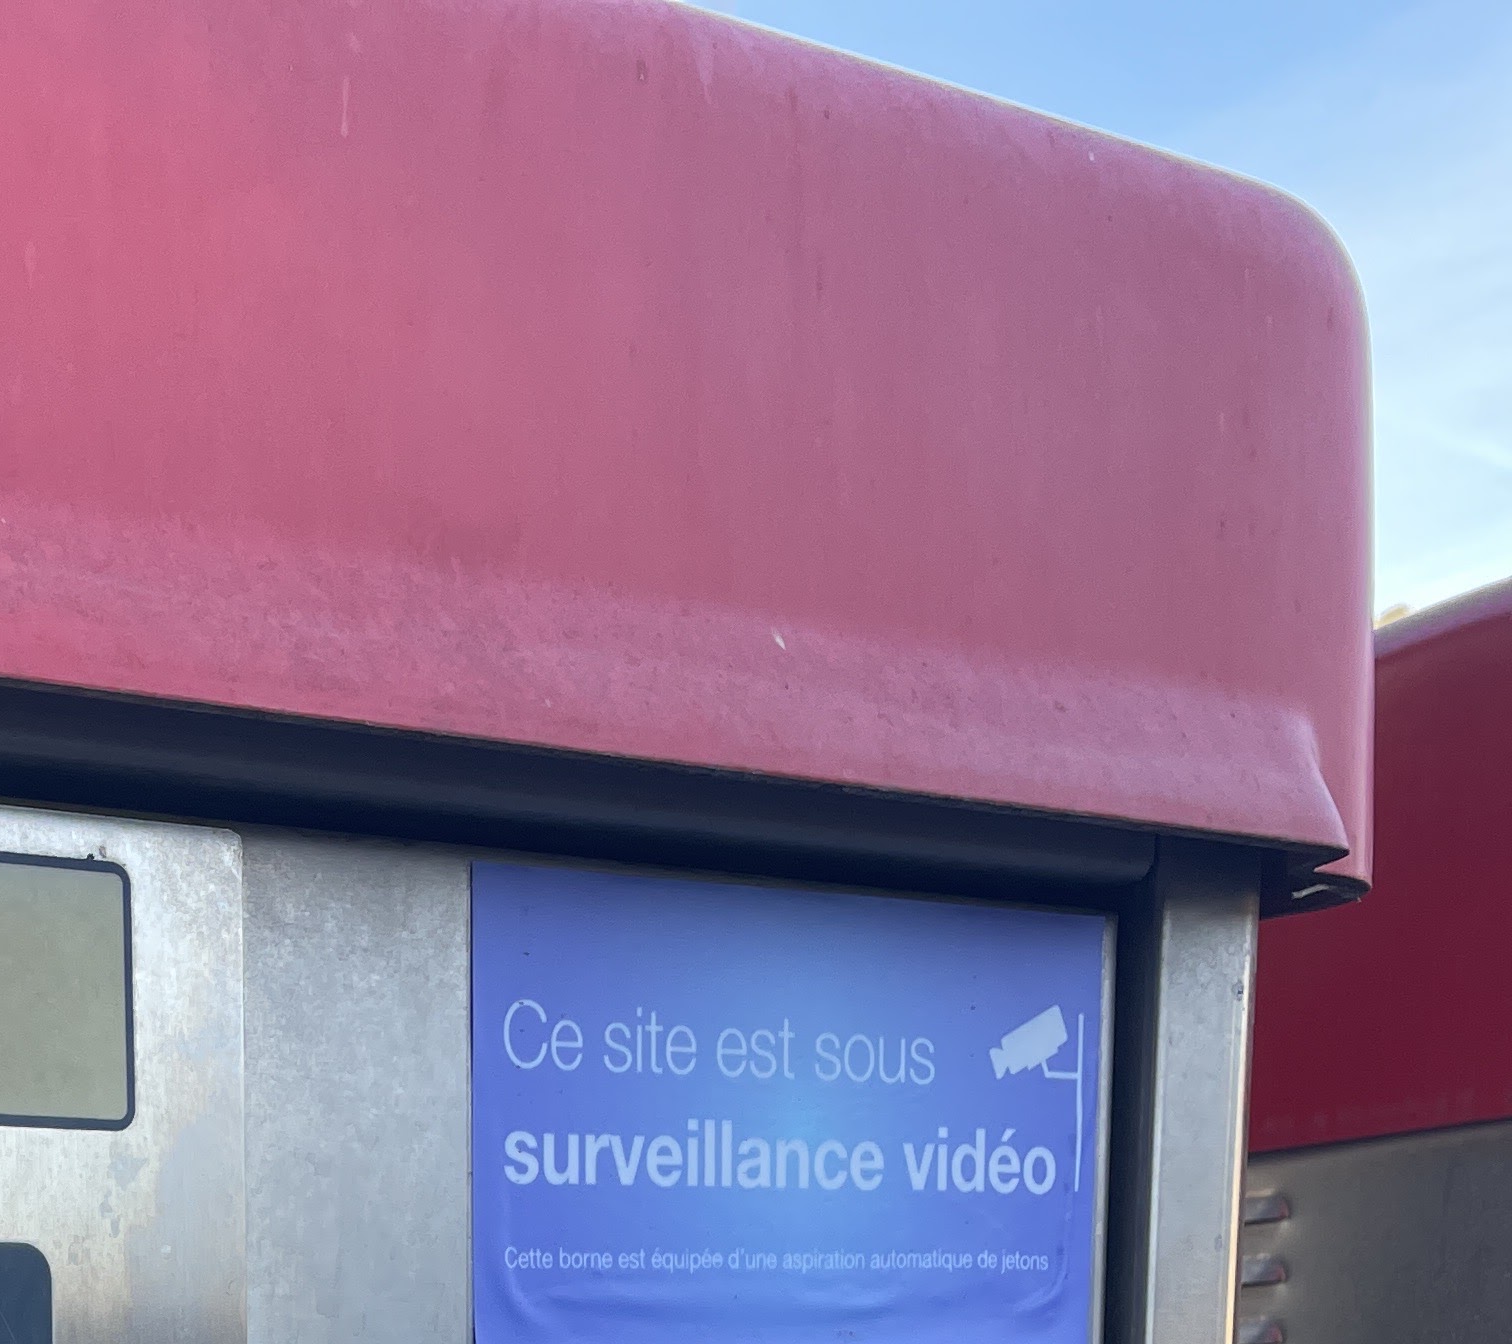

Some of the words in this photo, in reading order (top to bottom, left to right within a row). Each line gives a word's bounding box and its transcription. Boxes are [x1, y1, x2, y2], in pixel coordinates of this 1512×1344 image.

[503, 999, 583, 1071] Ce
[603, 1006, 697, 1075] site
[716, 1018, 795, 1080] est
[814, 1031, 935, 1086] sous
[503, 1118, 884, 1191] surveillance
[903, 1128, 1056, 1194] vidéo
[504, 1246, 553, 1269] Cette
[559, 1246, 613, 1269] borne
[618, 1248, 645, 1269] est
[651, 1247, 724, 1274] équipée
[728, 1247, 777, 1269] d'une
[782, 1248, 866, 1274] aspiration
[870, 1247, 973, 1273] automatique
[977, 1248, 997, 1269] de
